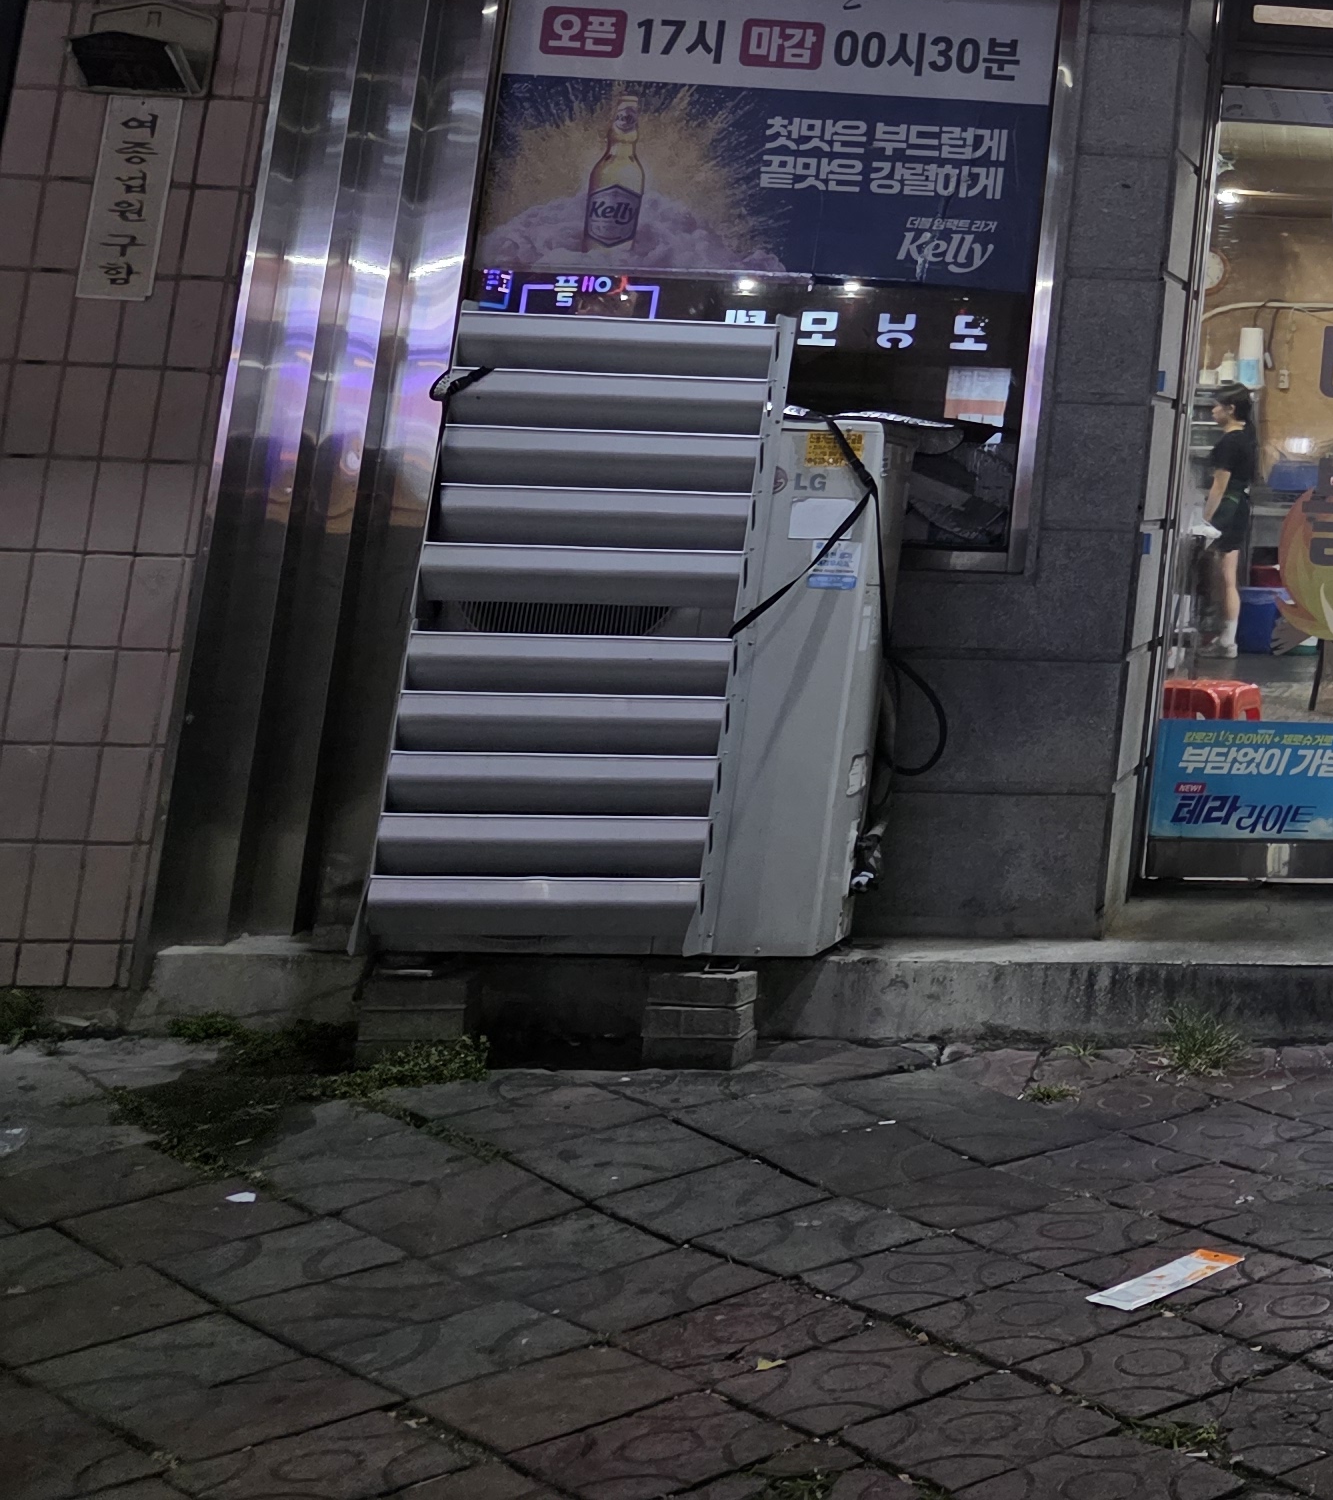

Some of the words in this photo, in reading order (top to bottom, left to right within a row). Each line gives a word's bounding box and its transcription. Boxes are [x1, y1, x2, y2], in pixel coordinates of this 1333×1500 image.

[546, 13, 618, 53] 오픈
[637, 19, 727, 65] 17시
[749, 26, 817, 65] 마감
[833, 29, 1021, 82] 00시30분
[765, 116, 867, 155] 첫맛은
[874, 123, 1008, 161] 부드럽게
[759, 155, 862, 195] 끝맛은
[869, 161, 1004, 200] 강렬하게
[589, 200, 638, 225] Kelly
[971, 220, 998, 234] 라거
[99, 233, 147, 286] 구함
[896, 231, 995, 274] Kelly
[793, 472, 828, 492] LG
[1178, 745, 1288, 777] 부담없이
